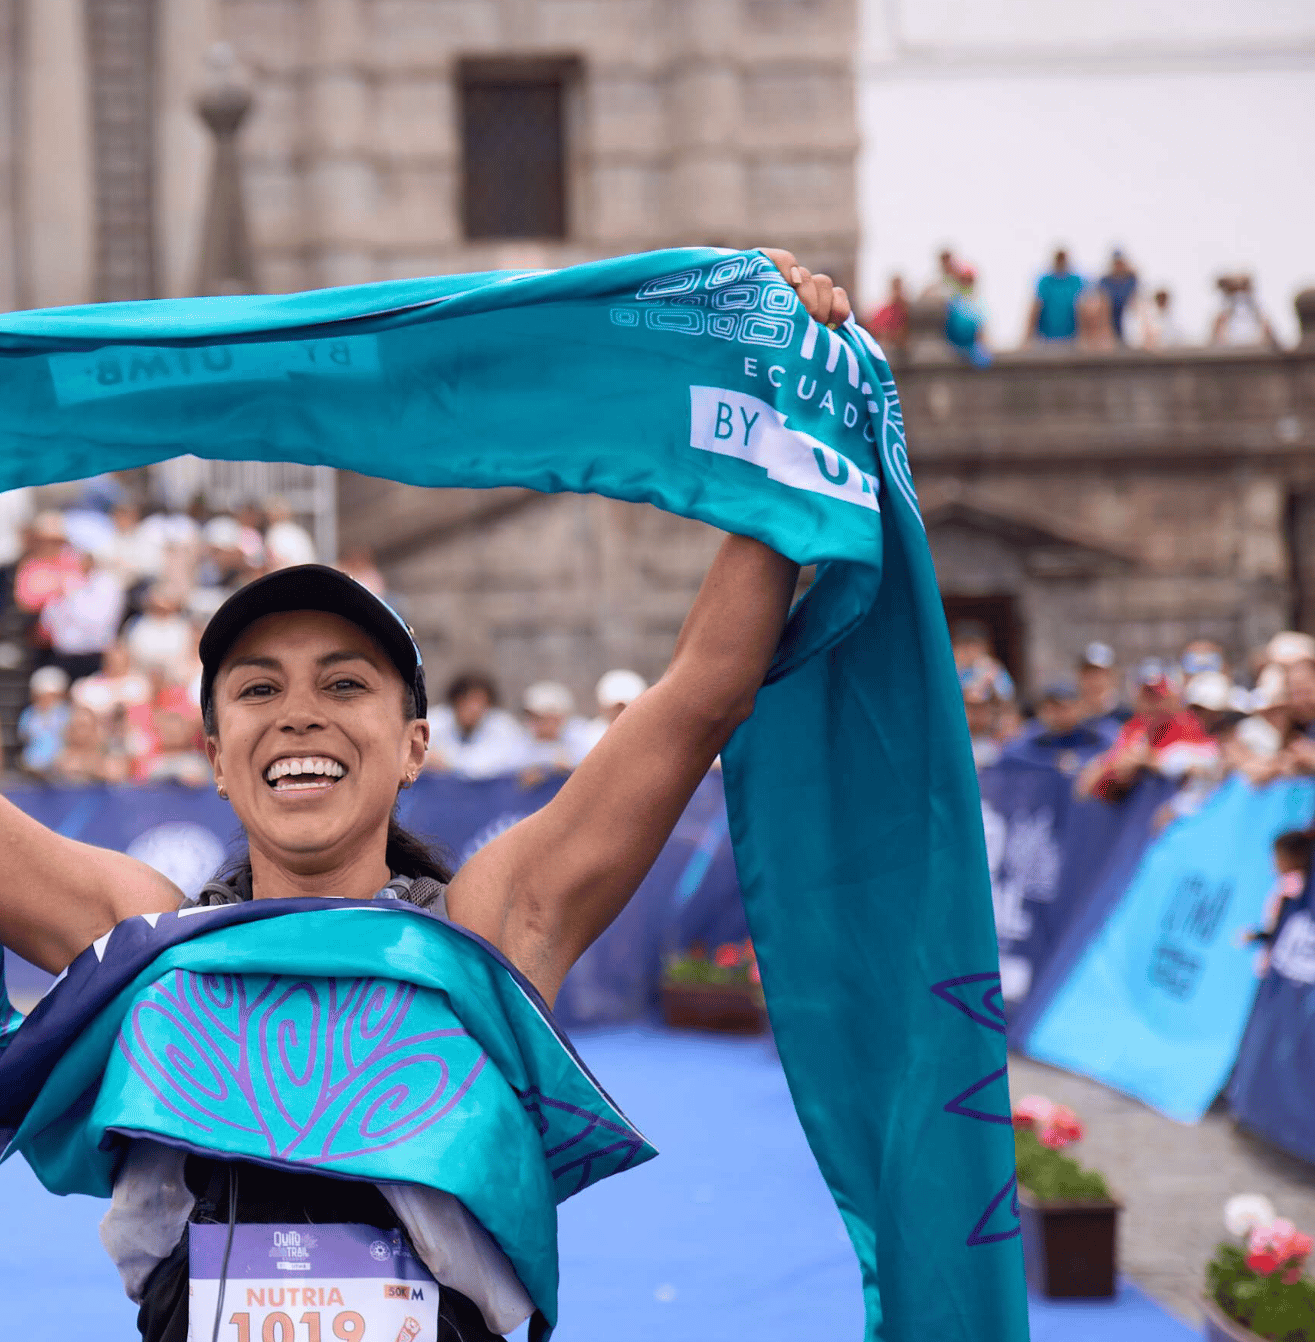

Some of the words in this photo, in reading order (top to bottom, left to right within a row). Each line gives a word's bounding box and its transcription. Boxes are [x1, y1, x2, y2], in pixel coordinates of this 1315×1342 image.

[744, 356, 876, 443] ECUADO
[715, 401, 760, 446] BY
[246, 1287, 345, 1307] NUTRIA
[411, 1287, 424, 1301] M
[228, 1310, 366, 1342] 1019
